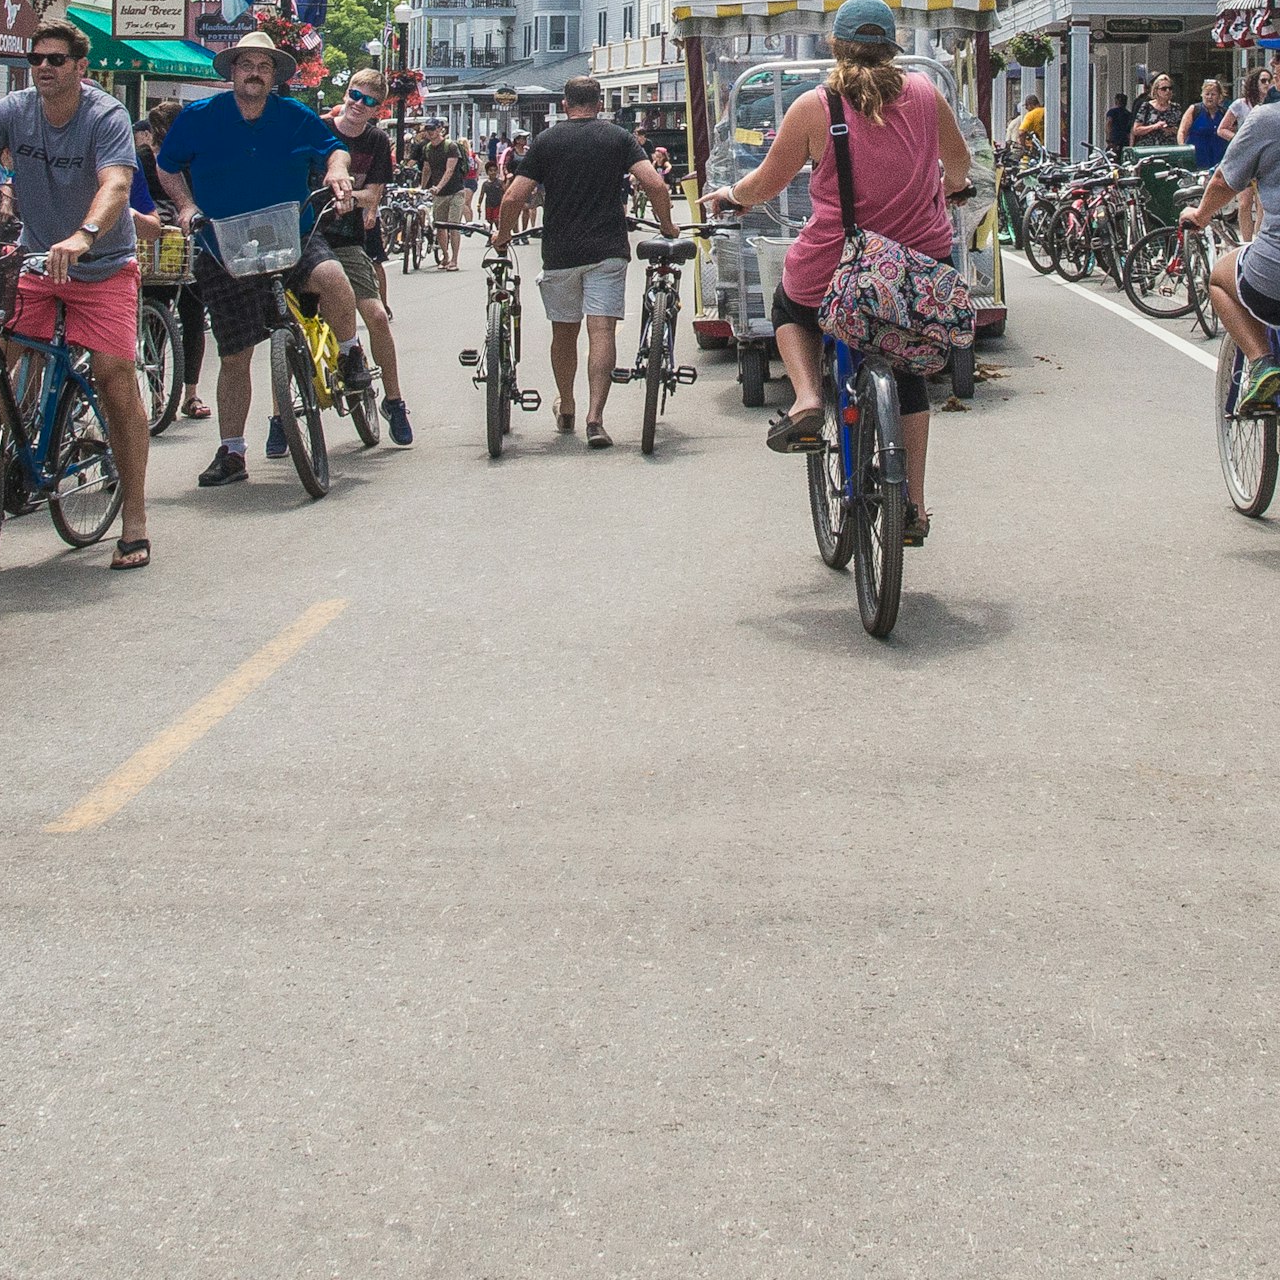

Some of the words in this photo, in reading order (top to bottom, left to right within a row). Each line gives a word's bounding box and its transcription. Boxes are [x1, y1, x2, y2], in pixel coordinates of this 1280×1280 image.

[120, 4, 147, 16] Island
[148, 4, 182, 16] Breeze
[125, 21, 139, 30] Fine
[140, 21, 153, 29] Art
[154, 21, 176, 30] Gallery
